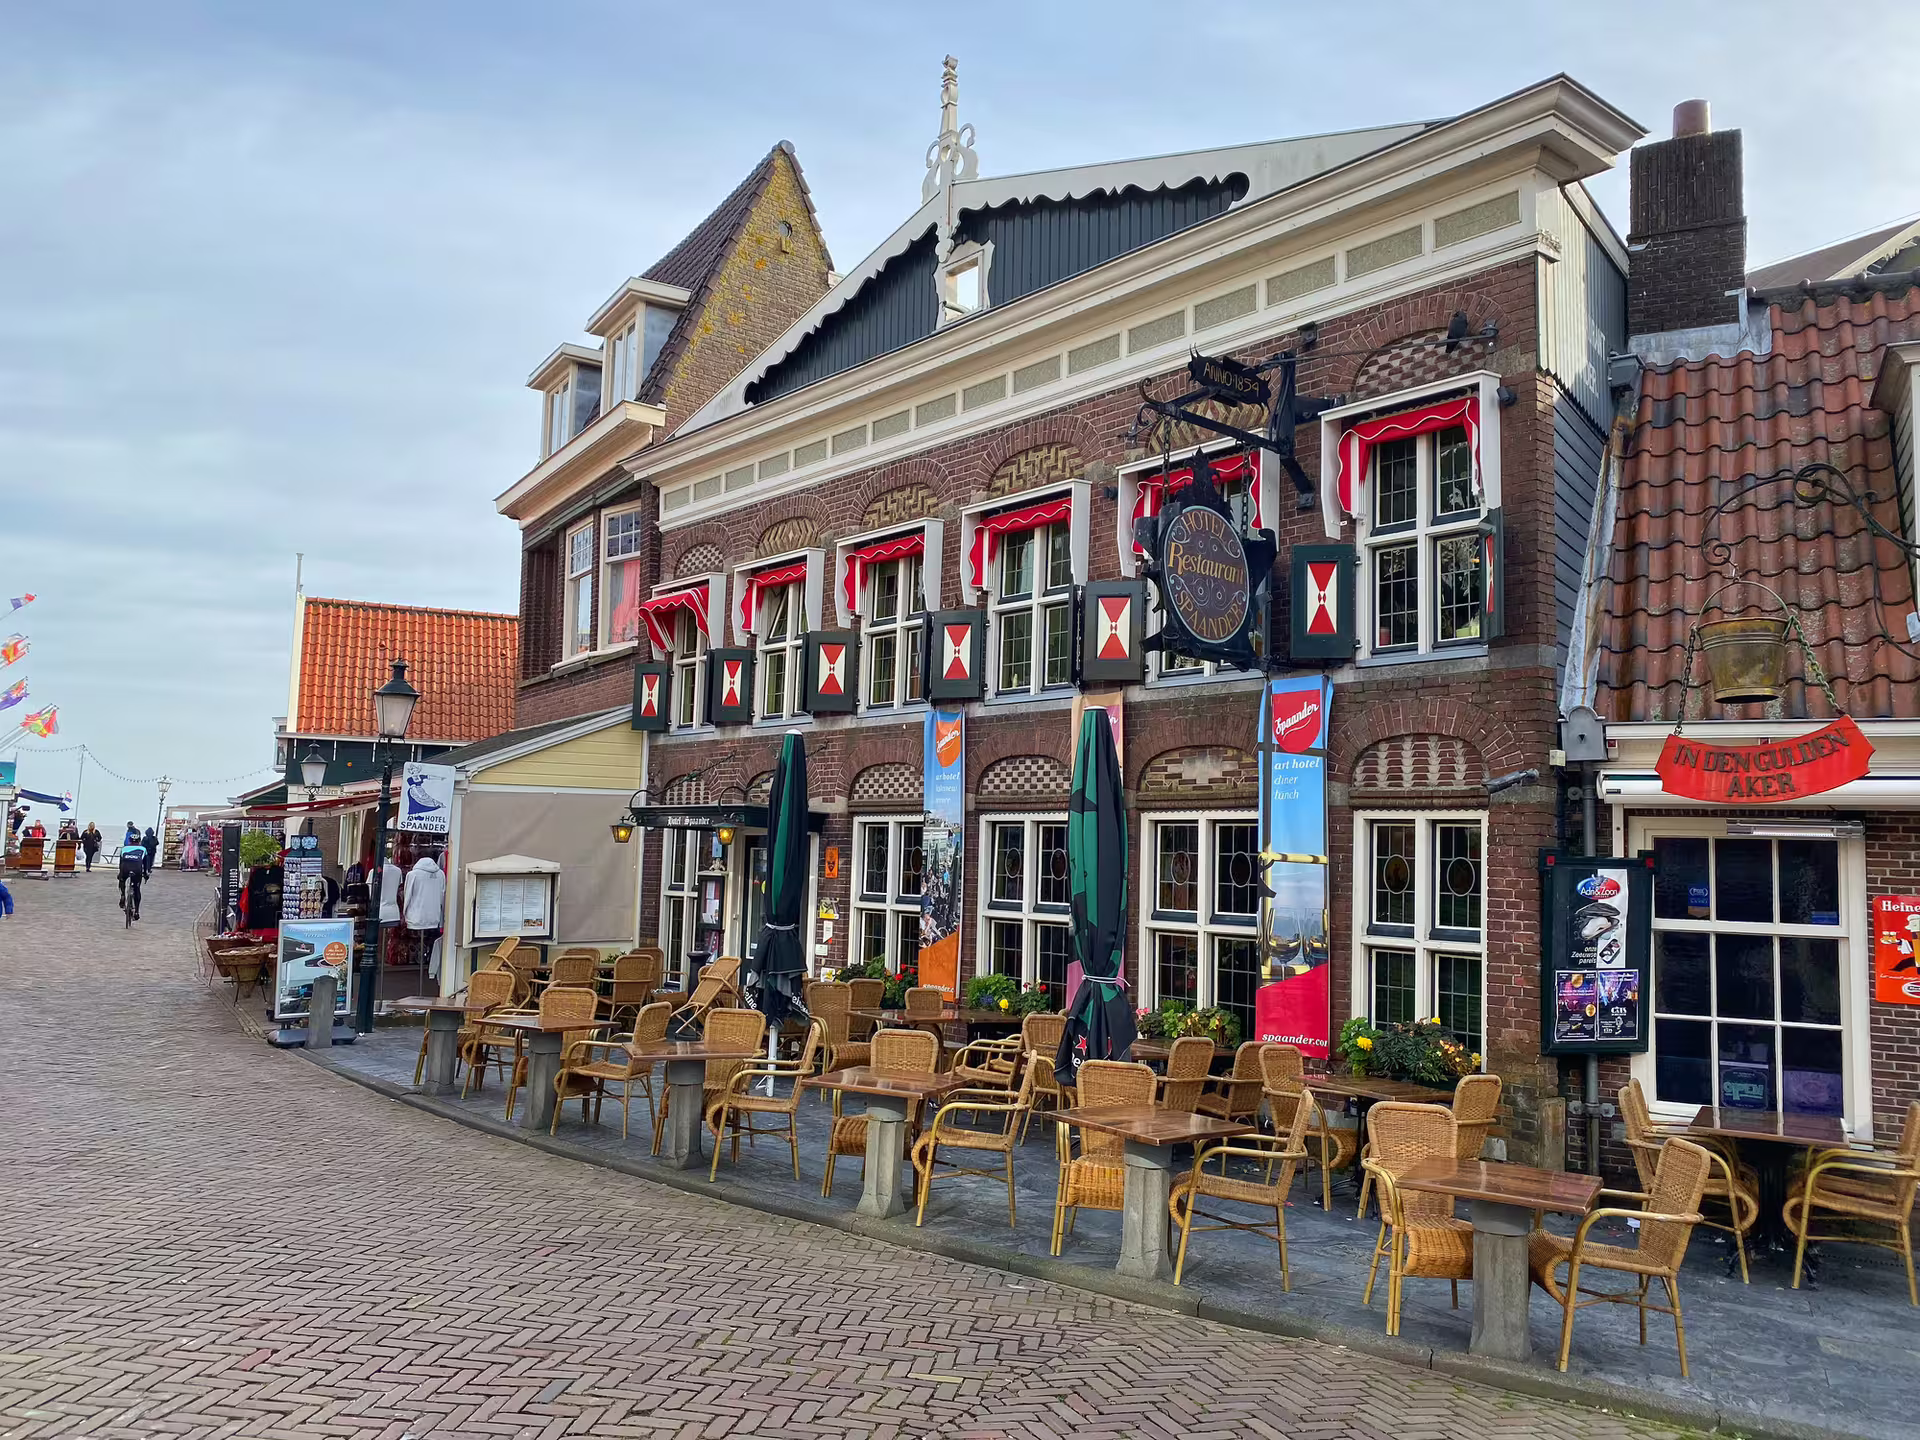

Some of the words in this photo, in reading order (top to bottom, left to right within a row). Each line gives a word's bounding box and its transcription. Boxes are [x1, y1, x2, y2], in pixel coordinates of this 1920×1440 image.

[1203, 362, 1232, 387] ANNO
[1233, 374, 1260, 398] 1854
[1181, 511, 1228, 543] HOTEL
[1168, 541, 1245, 585] Restaurant
[1175, 590, 1244, 639] SPAANDER
[1274, 701, 1320, 736] Spaander
[1673, 744, 1701, 768] IN
[1703, 751, 1750, 773] DEN
[1753, 727, 1850, 772] GULDEN
[1274, 760, 1289, 770] art
[1291, 758, 1320, 769] hotel
[1274, 775, 1298, 785] diner
[1727, 771, 1796, 798] AKER
[1274, 790, 1299, 800] lunch
[400, 821, 445, 832] SPAANDER
[425, 815, 446, 823] HOTEL
[667, 816, 681, 826] Hotel
[684, 816, 710, 826] Spaander
[1723, 1081, 1764, 1101] OPEN
